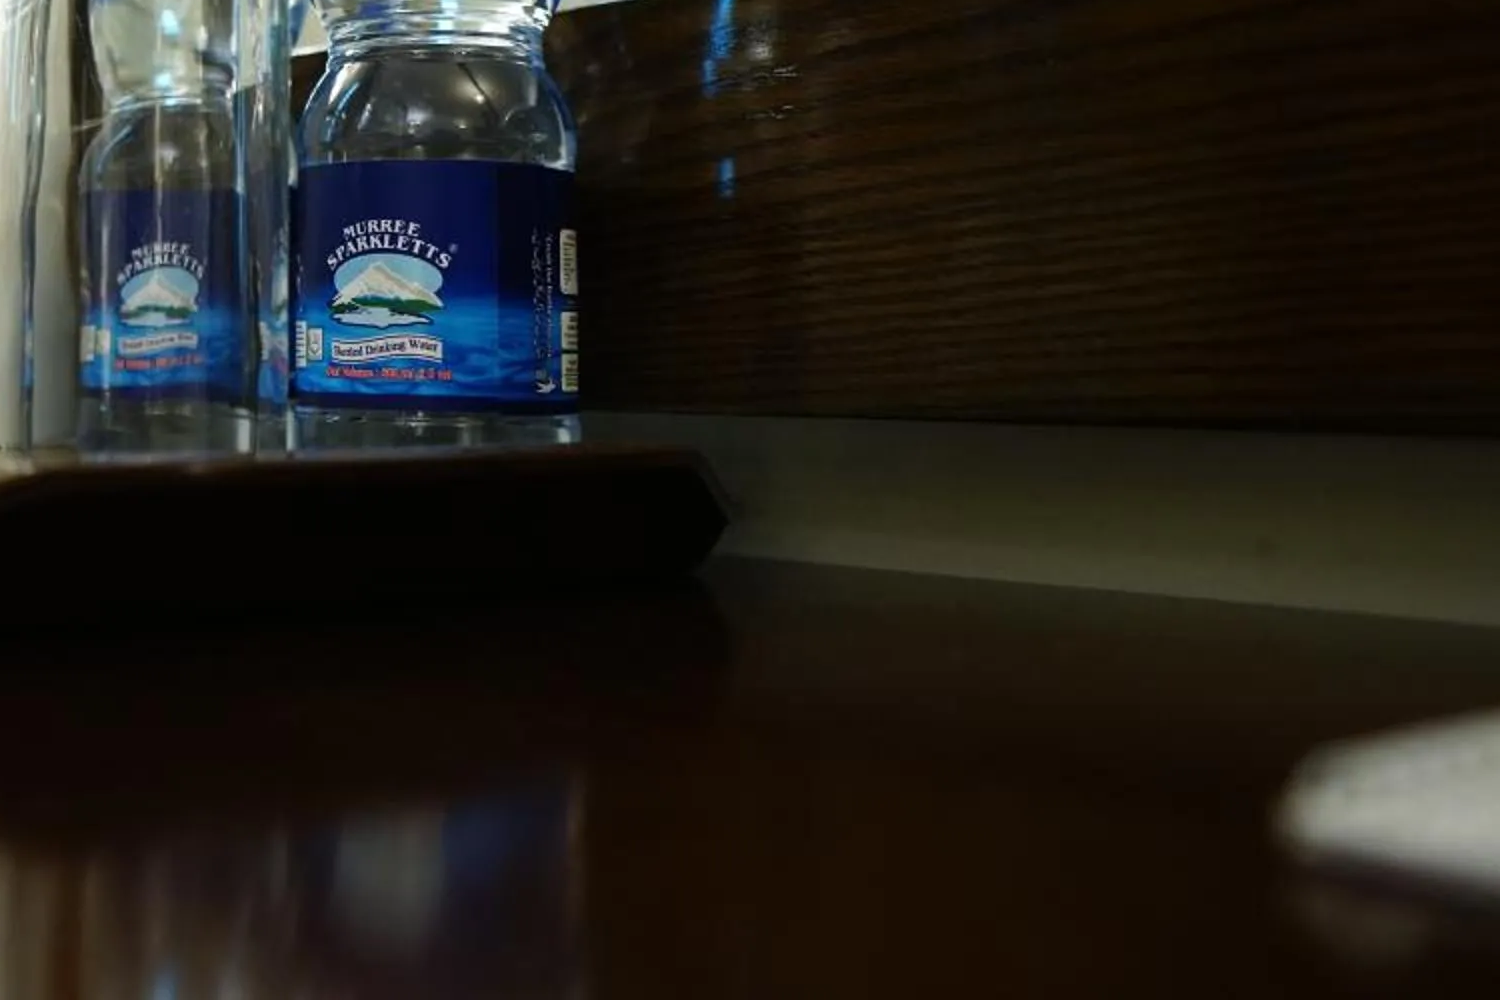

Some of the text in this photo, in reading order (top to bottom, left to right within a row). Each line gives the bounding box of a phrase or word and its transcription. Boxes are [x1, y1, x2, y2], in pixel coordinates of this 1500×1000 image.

[342, 219, 421, 240] MURREE
[326, 234, 453, 271] SPARKLETTS
[409, 338, 438, 351] Water
